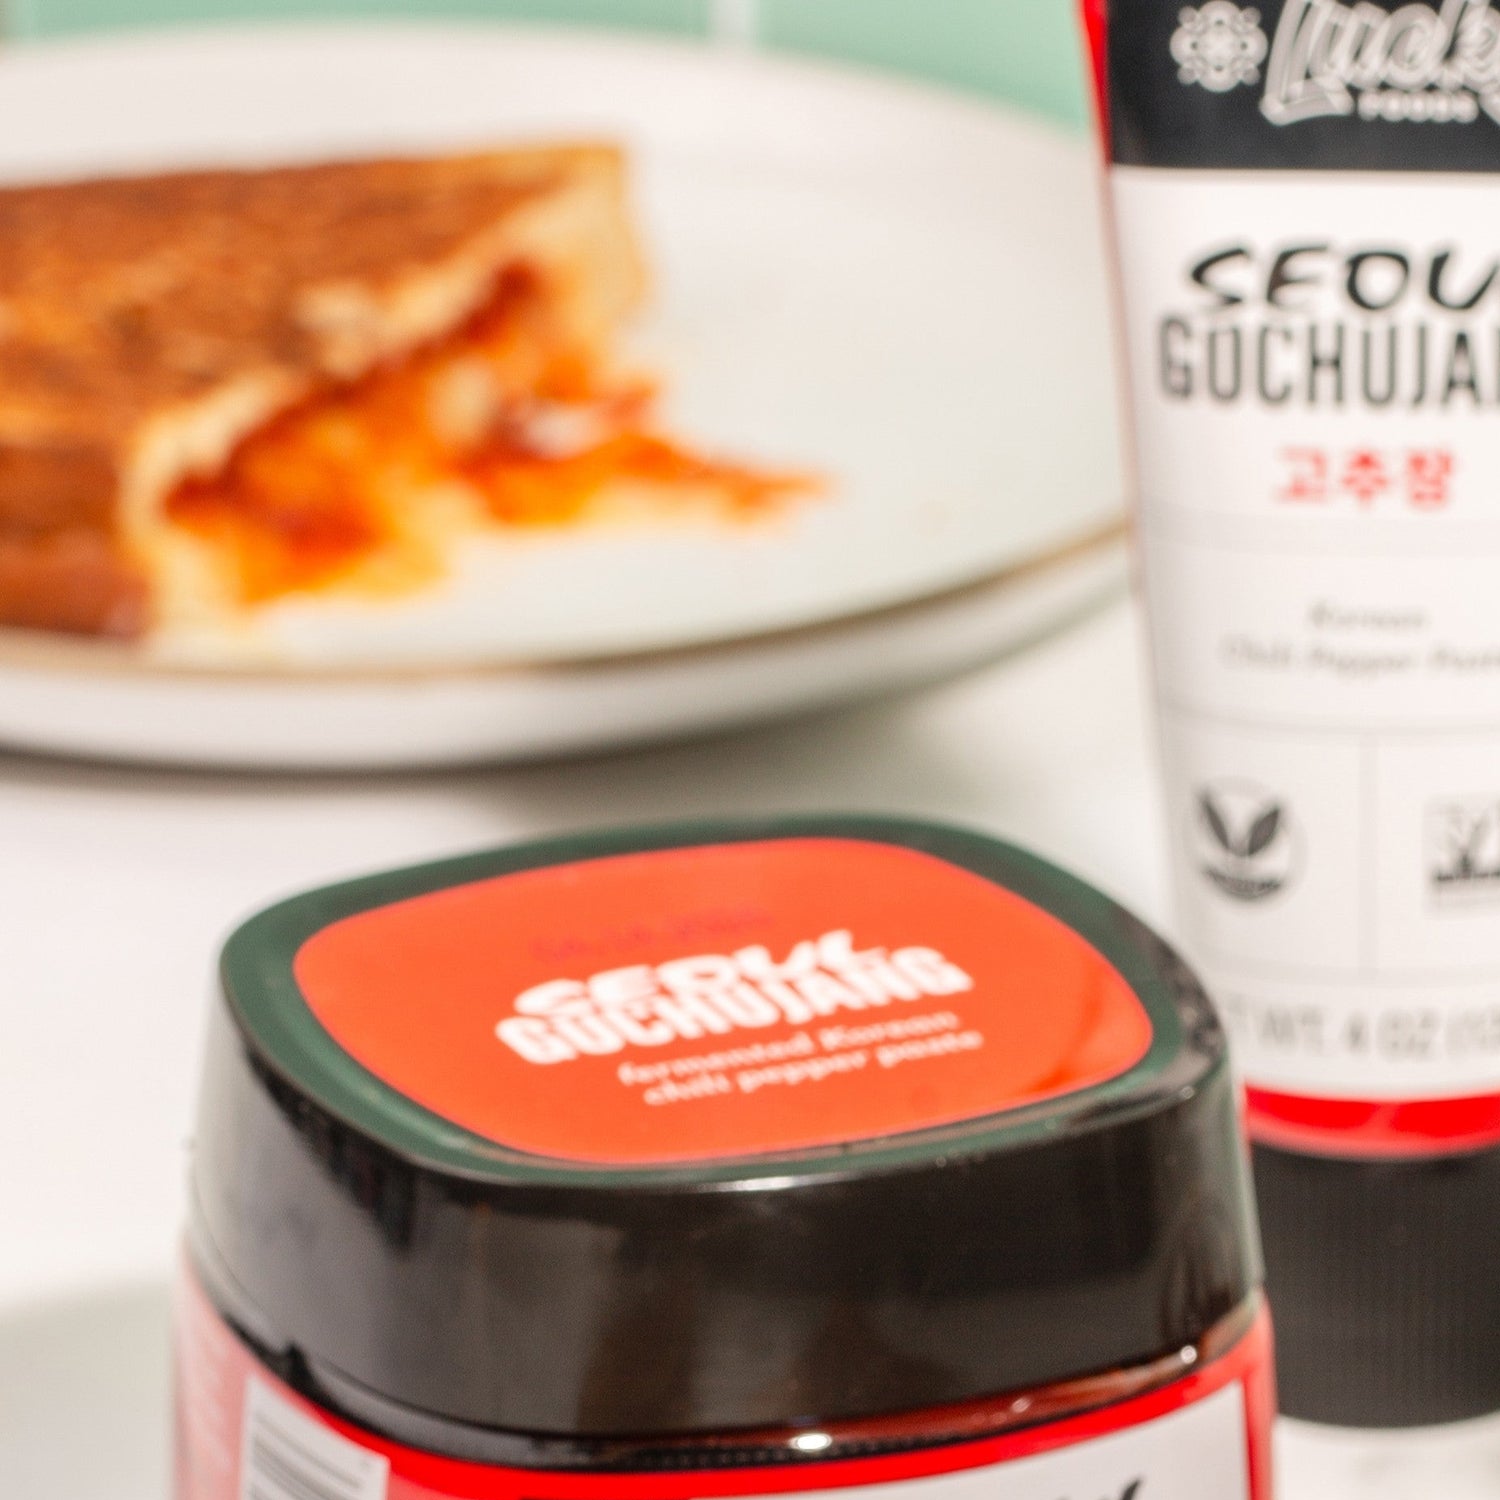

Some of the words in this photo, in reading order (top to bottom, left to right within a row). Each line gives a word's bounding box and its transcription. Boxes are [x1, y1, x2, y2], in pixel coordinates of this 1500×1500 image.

[496, 945, 974, 1064] GOCHUJANG
[617, 1031, 813, 1086] fermented
[819, 1011, 962, 1059] Korean
[642, 1071, 733, 1107] chili
[737, 1048, 868, 1095] pepper
